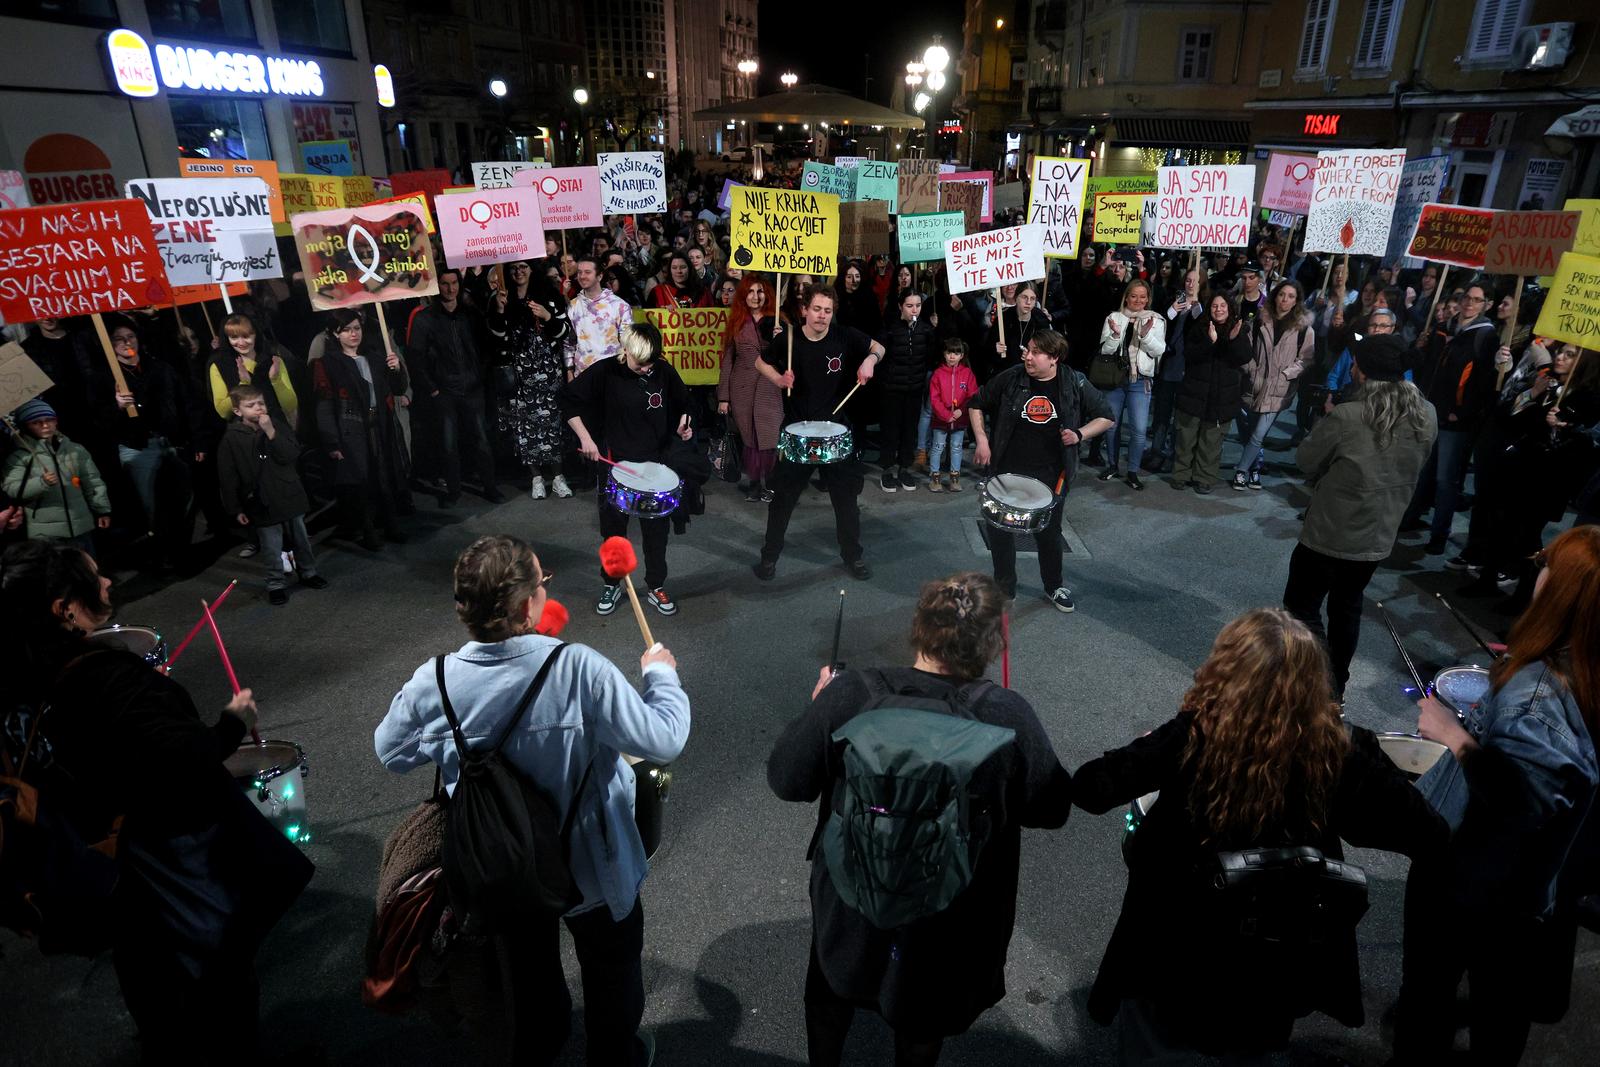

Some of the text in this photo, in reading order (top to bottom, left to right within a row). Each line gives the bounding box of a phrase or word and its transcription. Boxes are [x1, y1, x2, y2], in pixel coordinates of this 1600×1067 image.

[118, 65, 153, 81] KING
[156, 44, 269, 93] BURGER
[267, 57, 324, 97] KING
[1303, 114, 1341, 135] TISAK
[188, 164, 254, 173] JEDINO ŠTO
[600, 157, 663, 184] MARŠIRAMO
[822, 165, 850, 177] BORBA
[863, 162, 899, 180] ŽENA
[1039, 161, 1083, 182] LOV
[1317, 154, 1407, 170] DON'T FORGET
[29, 173, 120, 203] BURGER
[611, 178, 658, 193] NARIJED.
[820, 176, 831, 185] ZA
[1163, 170, 1227, 195] JA SAM
[1318, 168, 1364, 185] WHERE
[1370, 170, 1399, 190] YOU
[129, 183, 270, 218] NEPOSLUŠNE
[610, 195, 656, 210] NE NAZAD
[745, 190, 819, 216] NIJE KRHKA
[1045, 183, 1070, 202] NA
[1315, 186, 1357, 203] CAME
[1362, 188, 1395, 206] FROM
[459, 201, 520, 228] DOSTA!
[547, 205, 573, 213] uskrate
[1032, 200, 1078, 227] ŽENSKA
[1099, 197, 1127, 212] Svoga
[1161, 195, 1248, 220] SVOG TIJELA
[41, 208, 122, 235] NAŠIH
[572, 212, 590, 221] skrbi
[764, 213, 789, 233] KAO
[790, 215, 828, 237] CVIJET
[1431, 221, 1442, 231] SE
[1445, 223, 1455, 233] SA
[1491, 214, 1577, 240] ABORTUS
[305, 229, 410, 256] moja moj
[466, 232, 523, 248] zanemarivanja
[749, 231, 804, 254] KRHKA JE
[951, 228, 1021, 253] BINARNOST
[1158, 222, 1247, 246] GOSPODARICA
[111, 235, 147, 257] NA
[464, 243, 528, 260] ženskog zdravlja
[963, 246, 1010, 265] JE MIT
[1492, 244, 1554, 269] SVIMA
[215, 247, 276, 281] povijest
[764, 252, 832, 273] KAO BOMBA
[996, 262, 1025, 281] VRIT
[0, 261, 147, 300] SVAČIJIM JE
[312, 255, 429, 292] pička simbol
[1564, 284, 1581, 296] SEX
[28, 288, 137, 319] RUKAMA
[646, 311, 728, 329] SLOBODA
